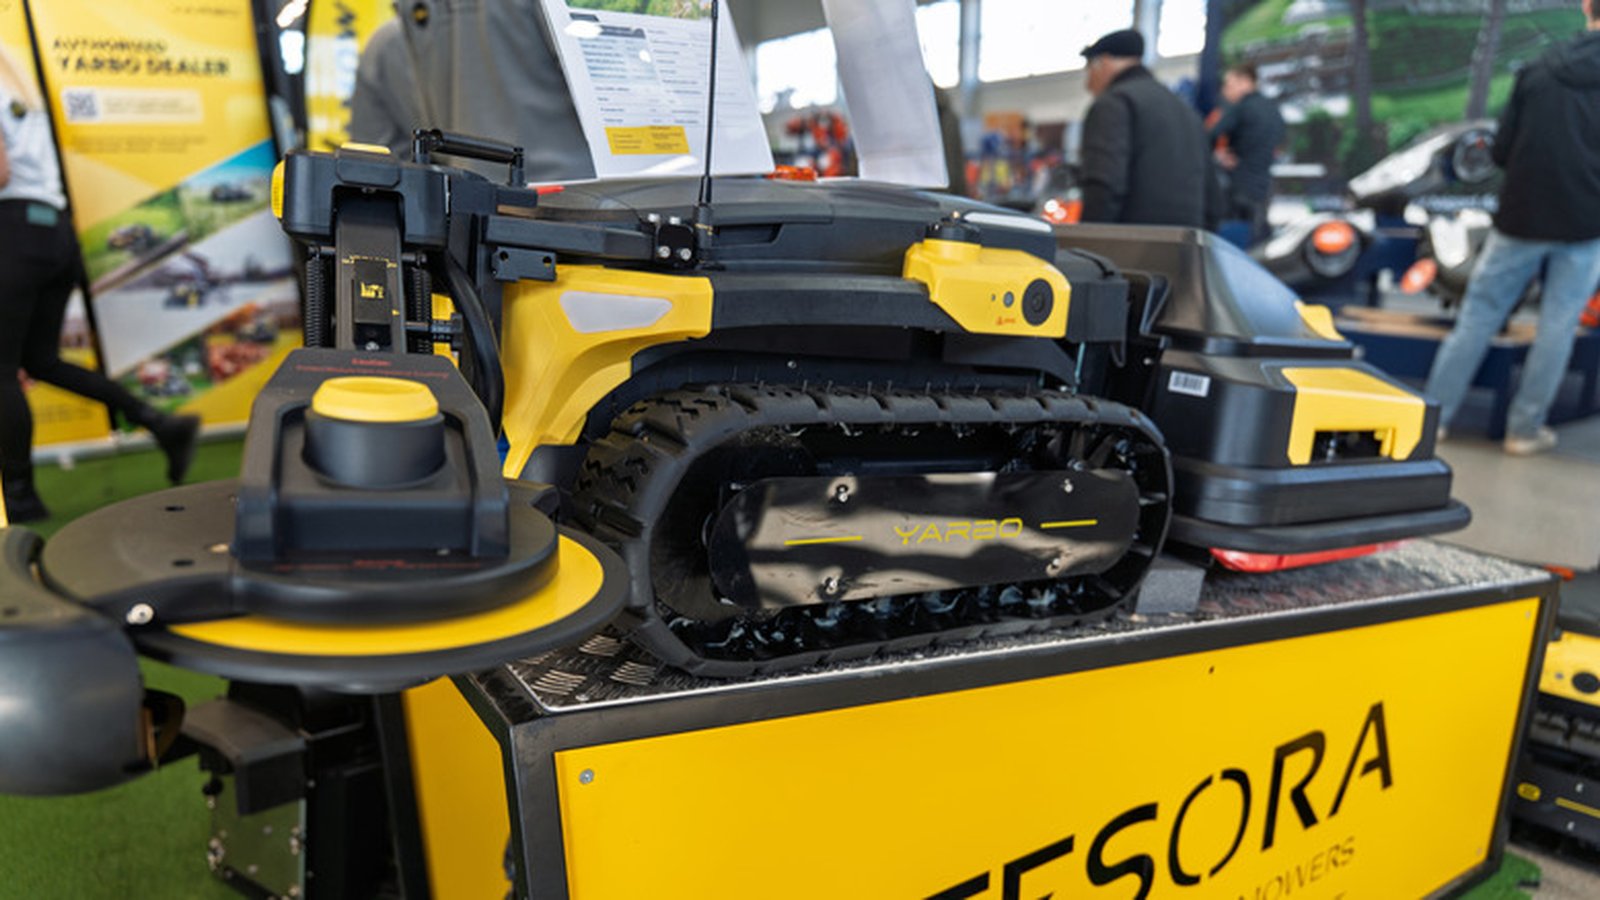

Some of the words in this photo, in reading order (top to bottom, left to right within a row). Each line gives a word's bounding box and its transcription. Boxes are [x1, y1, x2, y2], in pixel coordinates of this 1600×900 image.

[58, 56, 141, 73] YARBO
[893, 516, 1023, 545] YARBO
[921, 700, 1394, 900] SORA
[1238, 835, 1355, 900] OWERS
